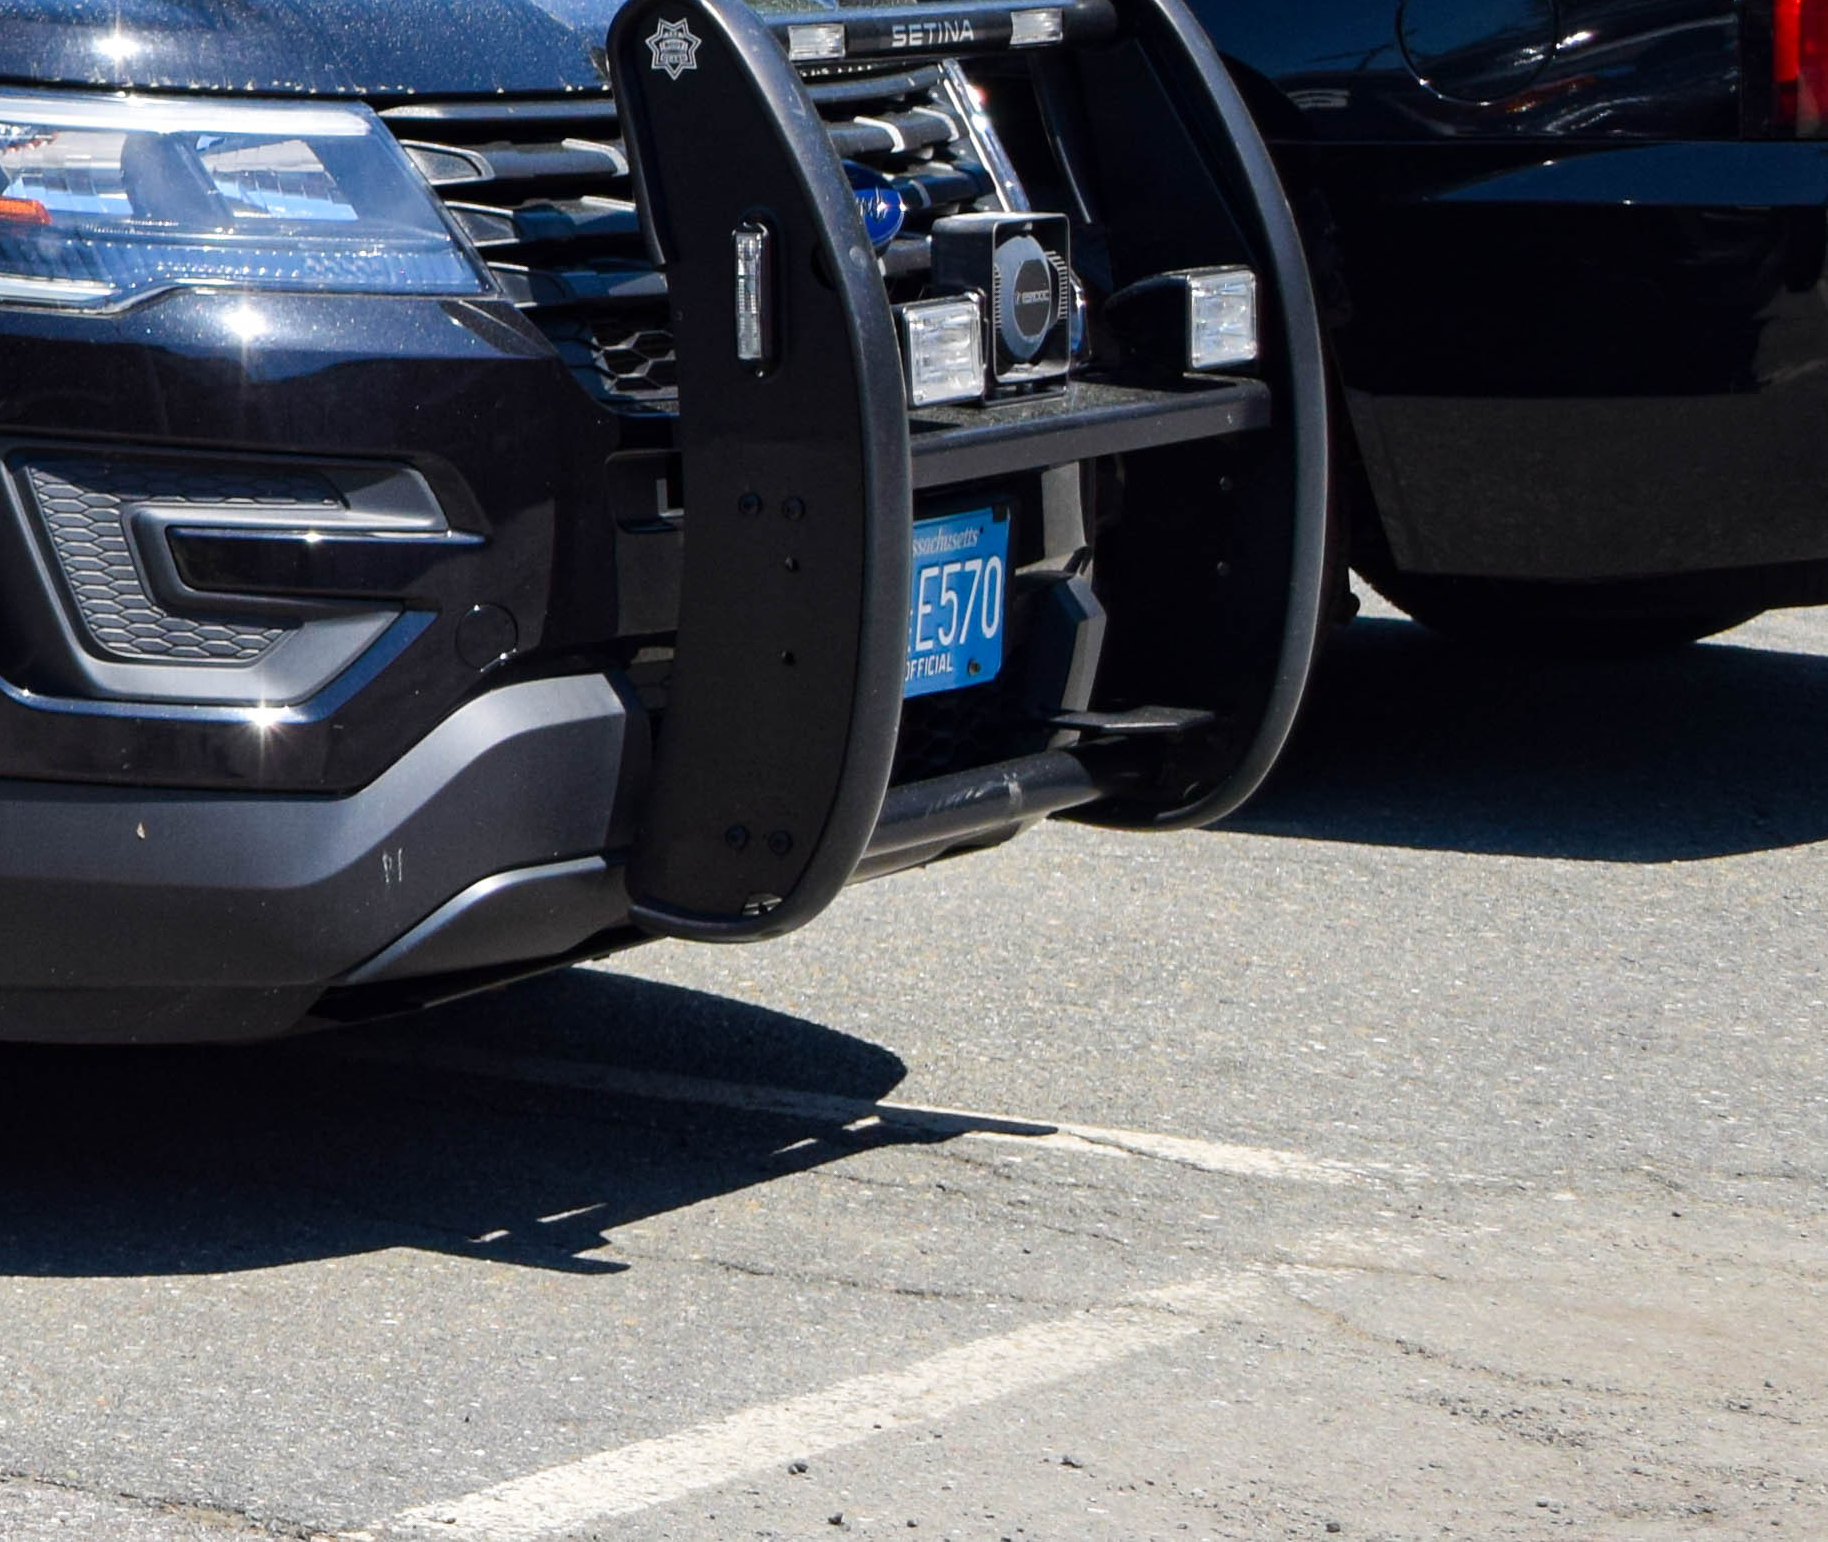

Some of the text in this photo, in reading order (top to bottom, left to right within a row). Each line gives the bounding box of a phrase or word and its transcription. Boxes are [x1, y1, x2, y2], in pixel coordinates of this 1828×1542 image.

[892, 19, 975, 48] SETINA
[913, 526, 980, 556] ssachusetts
[908, 555, 1002, 653] E570
